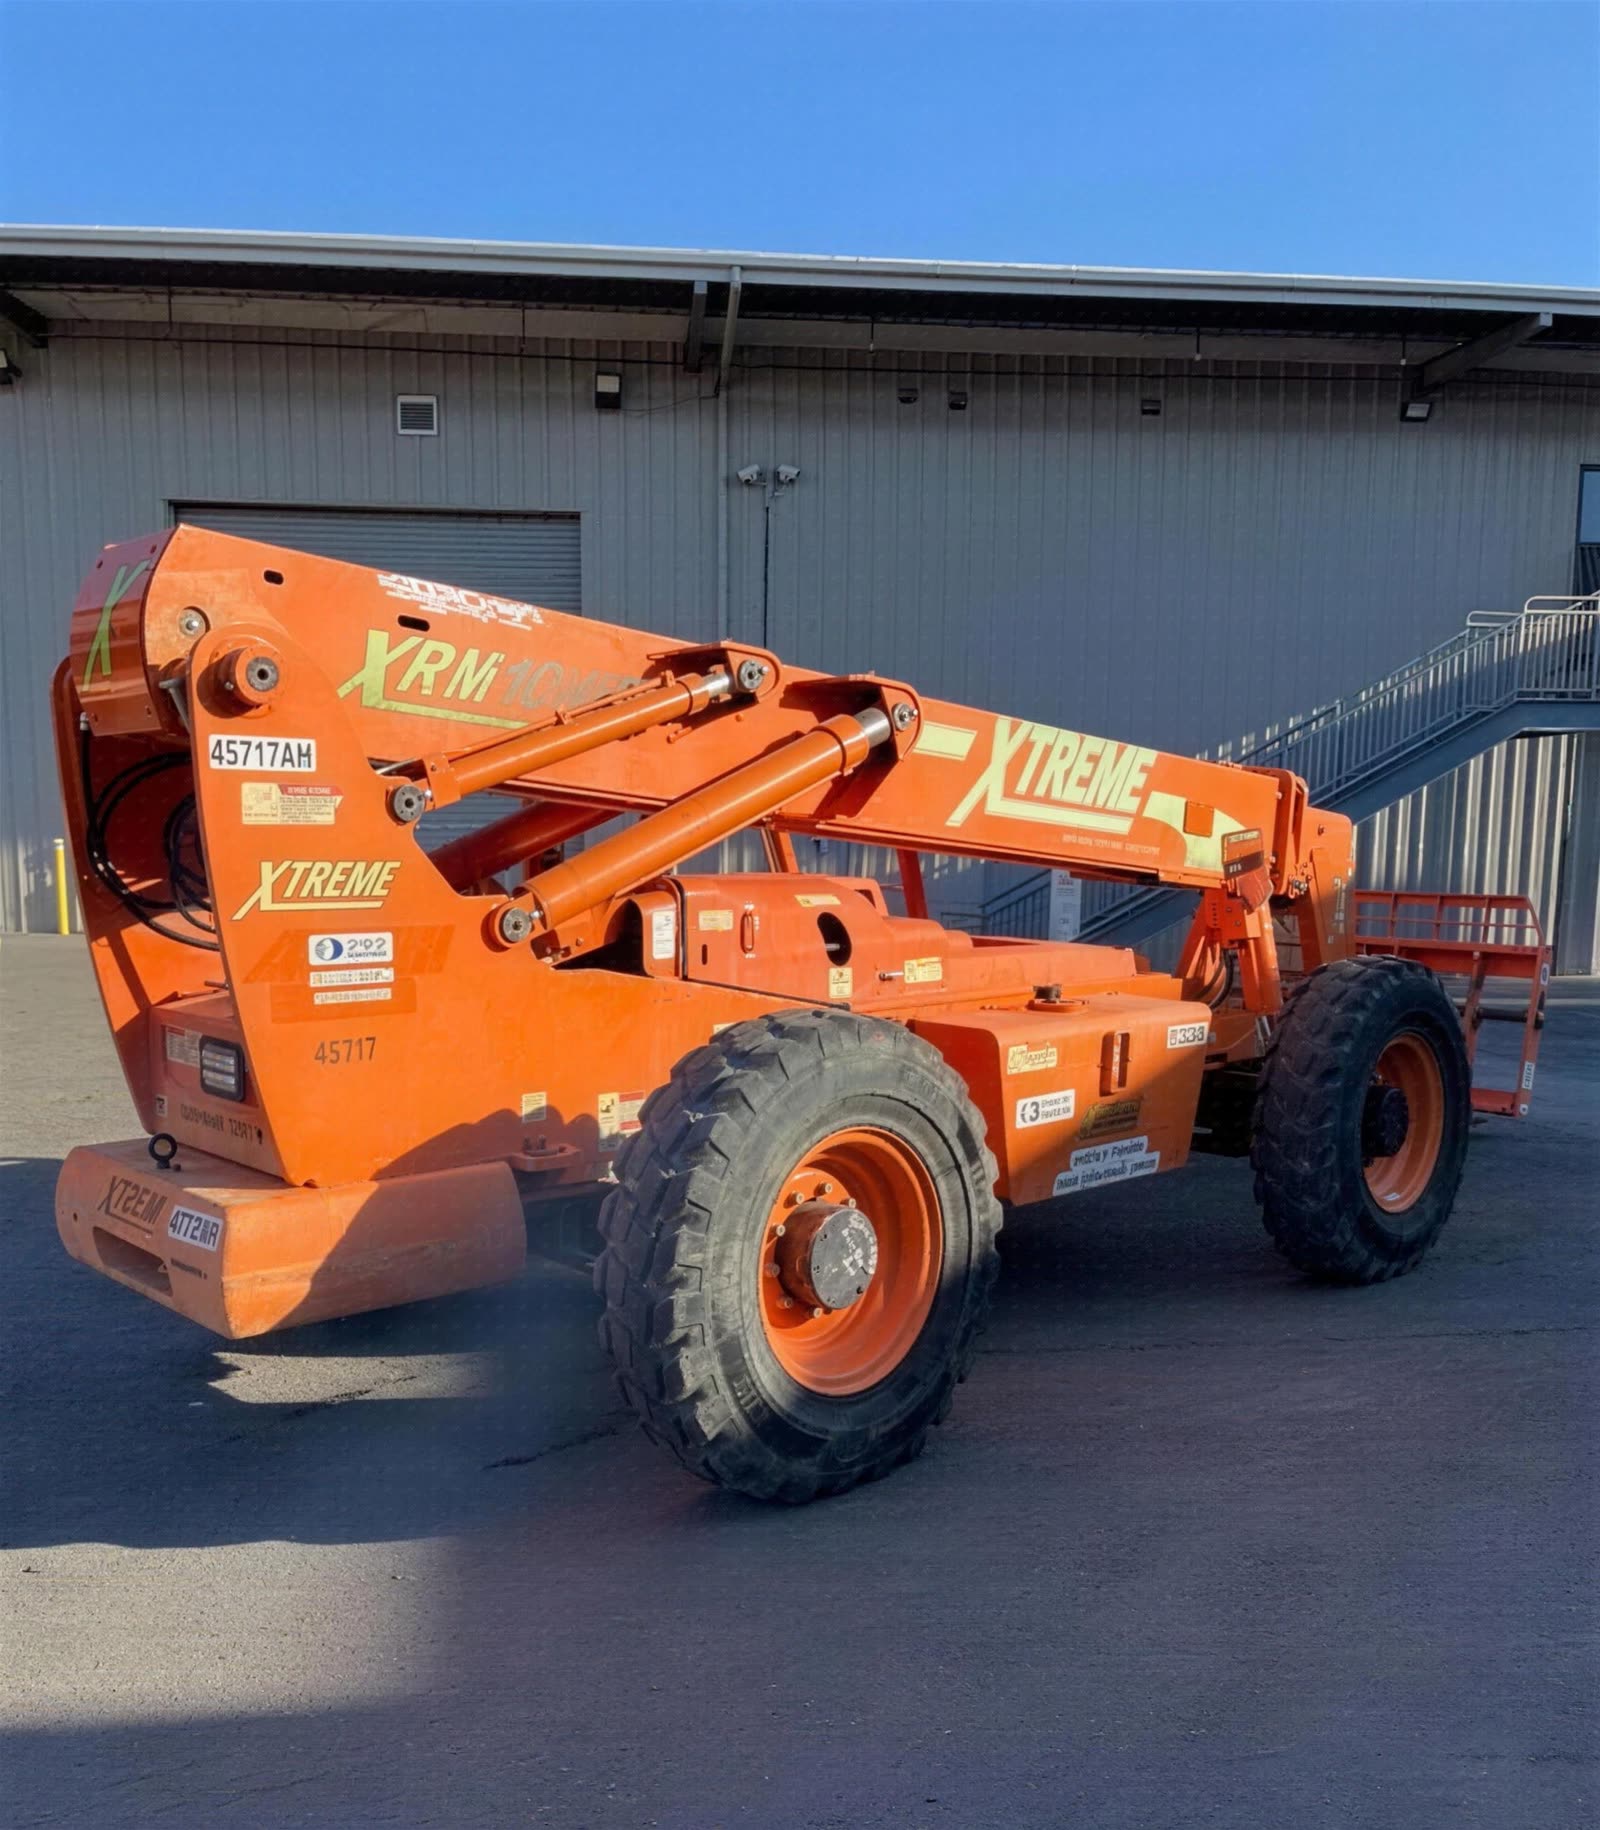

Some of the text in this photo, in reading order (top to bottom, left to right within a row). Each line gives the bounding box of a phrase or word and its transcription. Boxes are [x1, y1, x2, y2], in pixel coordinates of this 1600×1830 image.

[211, 739, 312, 768] 45717AH
[945, 716, 1158, 828] XTREME
[231, 860, 401, 920] XTREME
[314, 1036, 377, 1065] 45717
